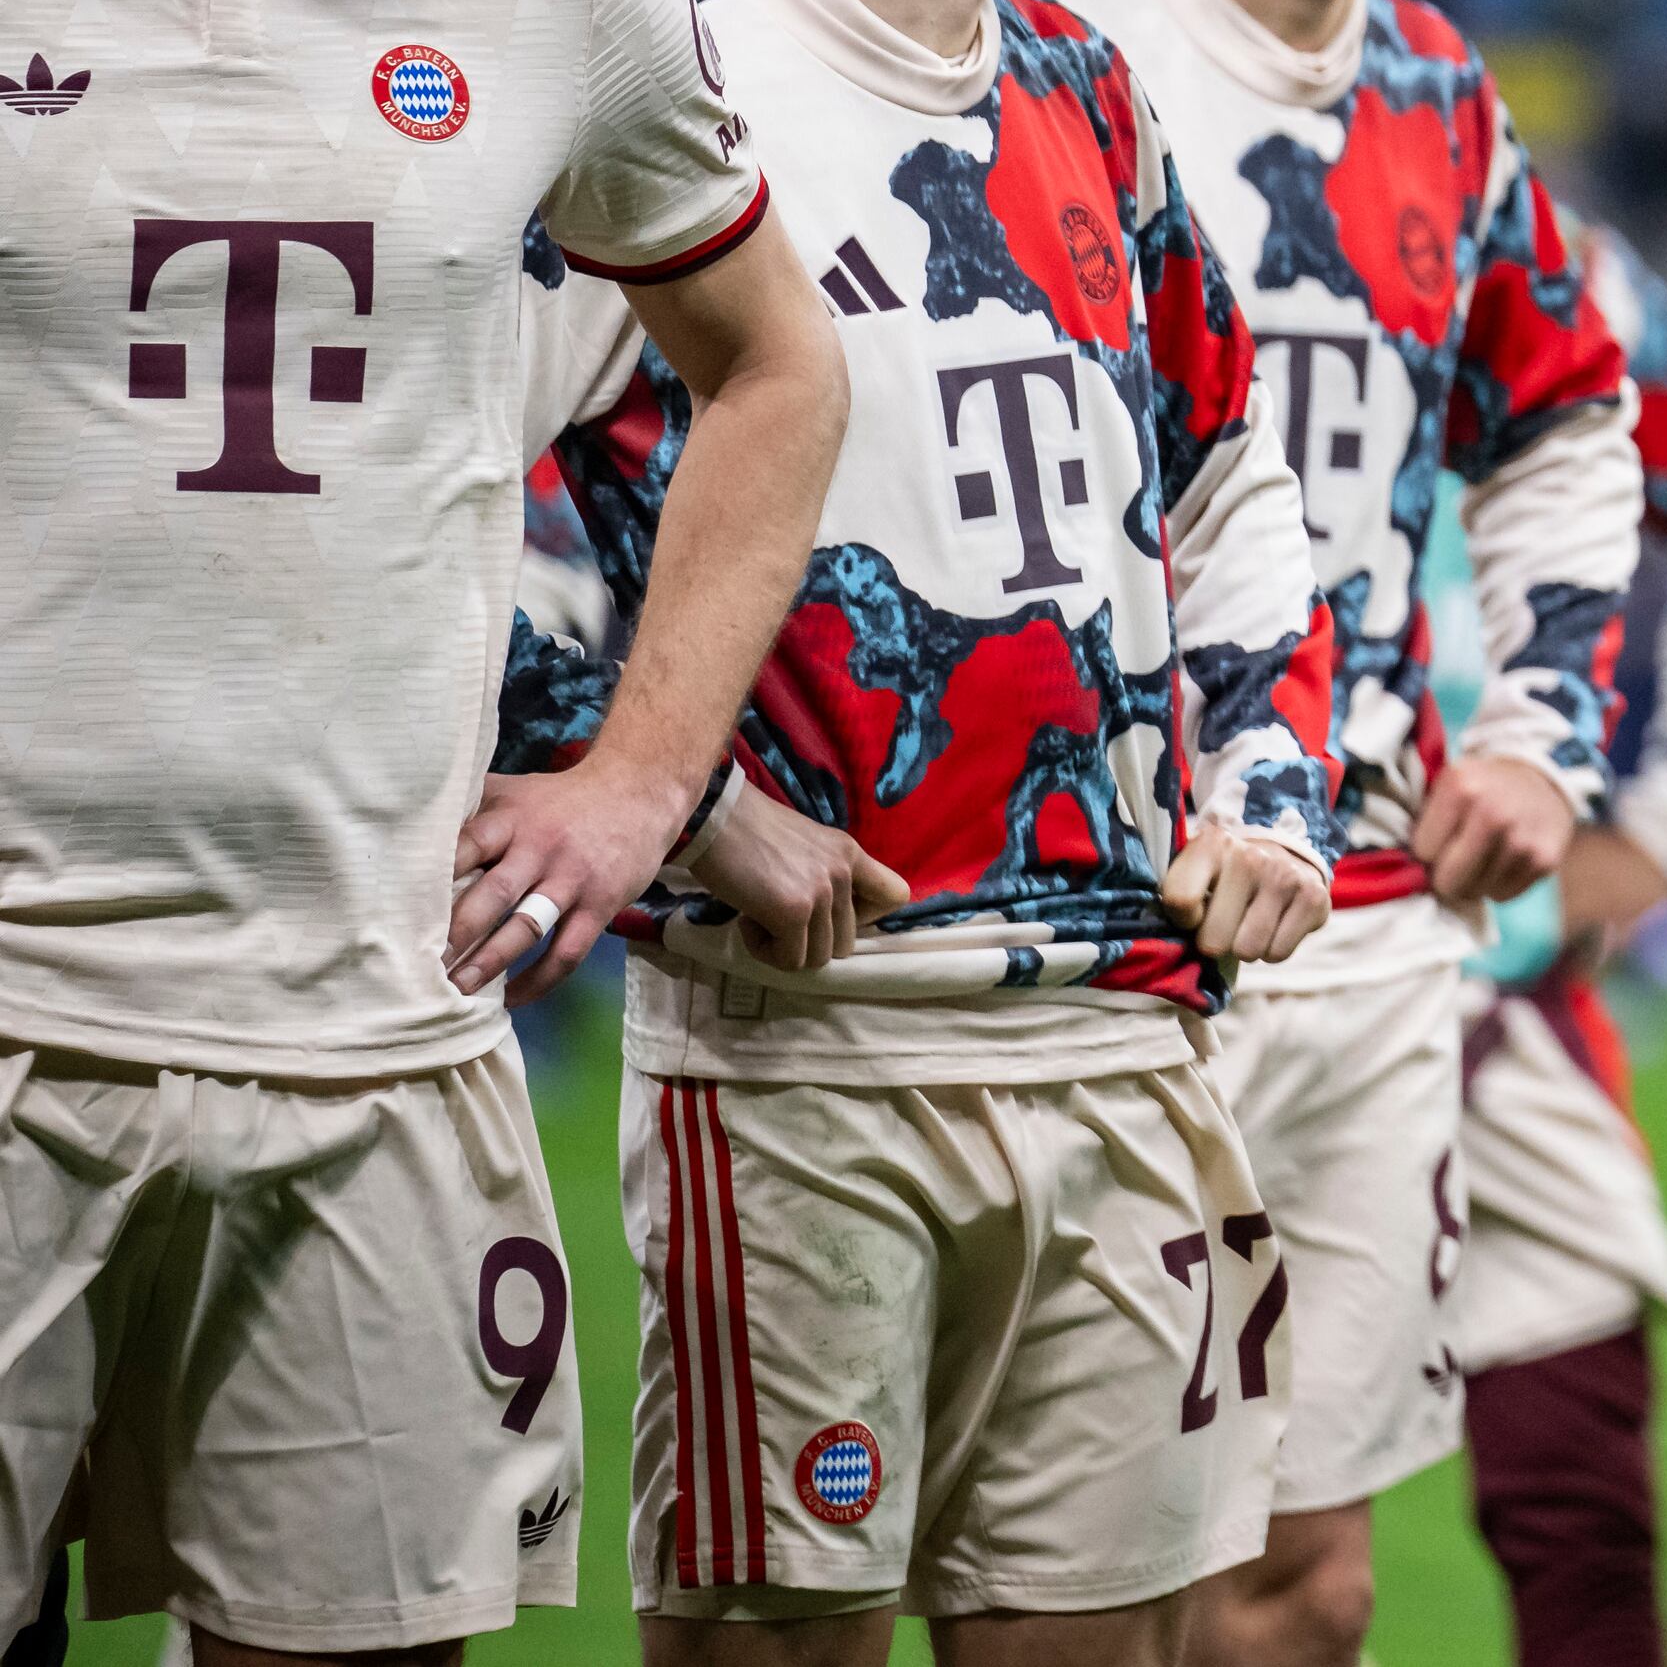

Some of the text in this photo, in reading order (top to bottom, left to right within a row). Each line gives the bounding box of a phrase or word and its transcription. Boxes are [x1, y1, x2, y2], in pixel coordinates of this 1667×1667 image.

[403, 48, 460, 81] BAYERN
[129, 219, 375, 495] T
[936, 353, 1090, 595] T
[478, 1237, 567, 1435] 9
[837, 1426, 879, 1458] BAYE
